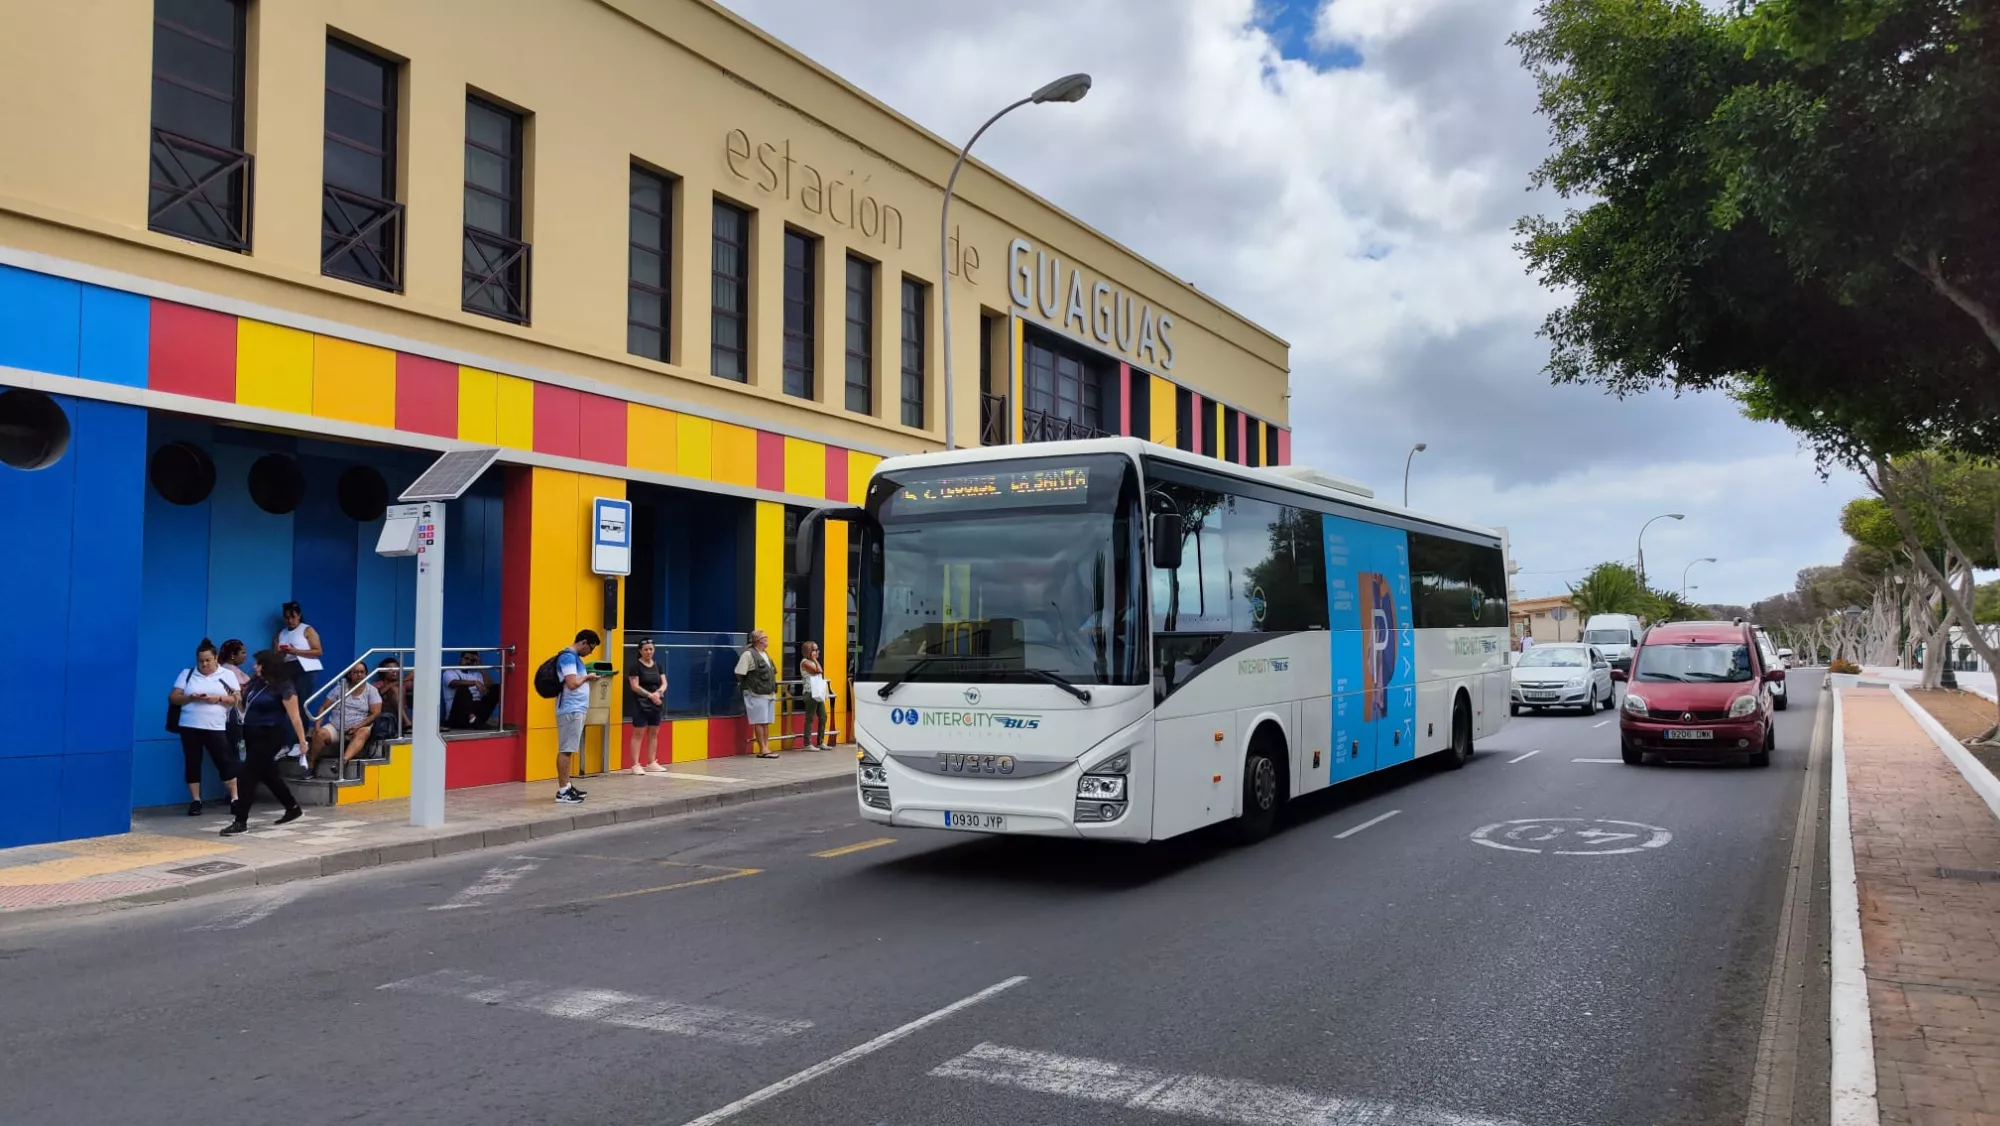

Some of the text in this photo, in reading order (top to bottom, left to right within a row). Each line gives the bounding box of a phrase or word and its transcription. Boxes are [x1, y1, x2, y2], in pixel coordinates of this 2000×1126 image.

[726, 128, 980, 286] estación de
[1008, 237, 1175, 371] GUAGUAS
[1033, 469, 1087, 488] SANTA
[1396, 545, 1412, 739] PRIMARK
[923, 712, 1040, 729] INTERCITY BUS
[940, 753, 1015, 774] IVECO
[952, 813, 1003, 828] 0930 JYP
